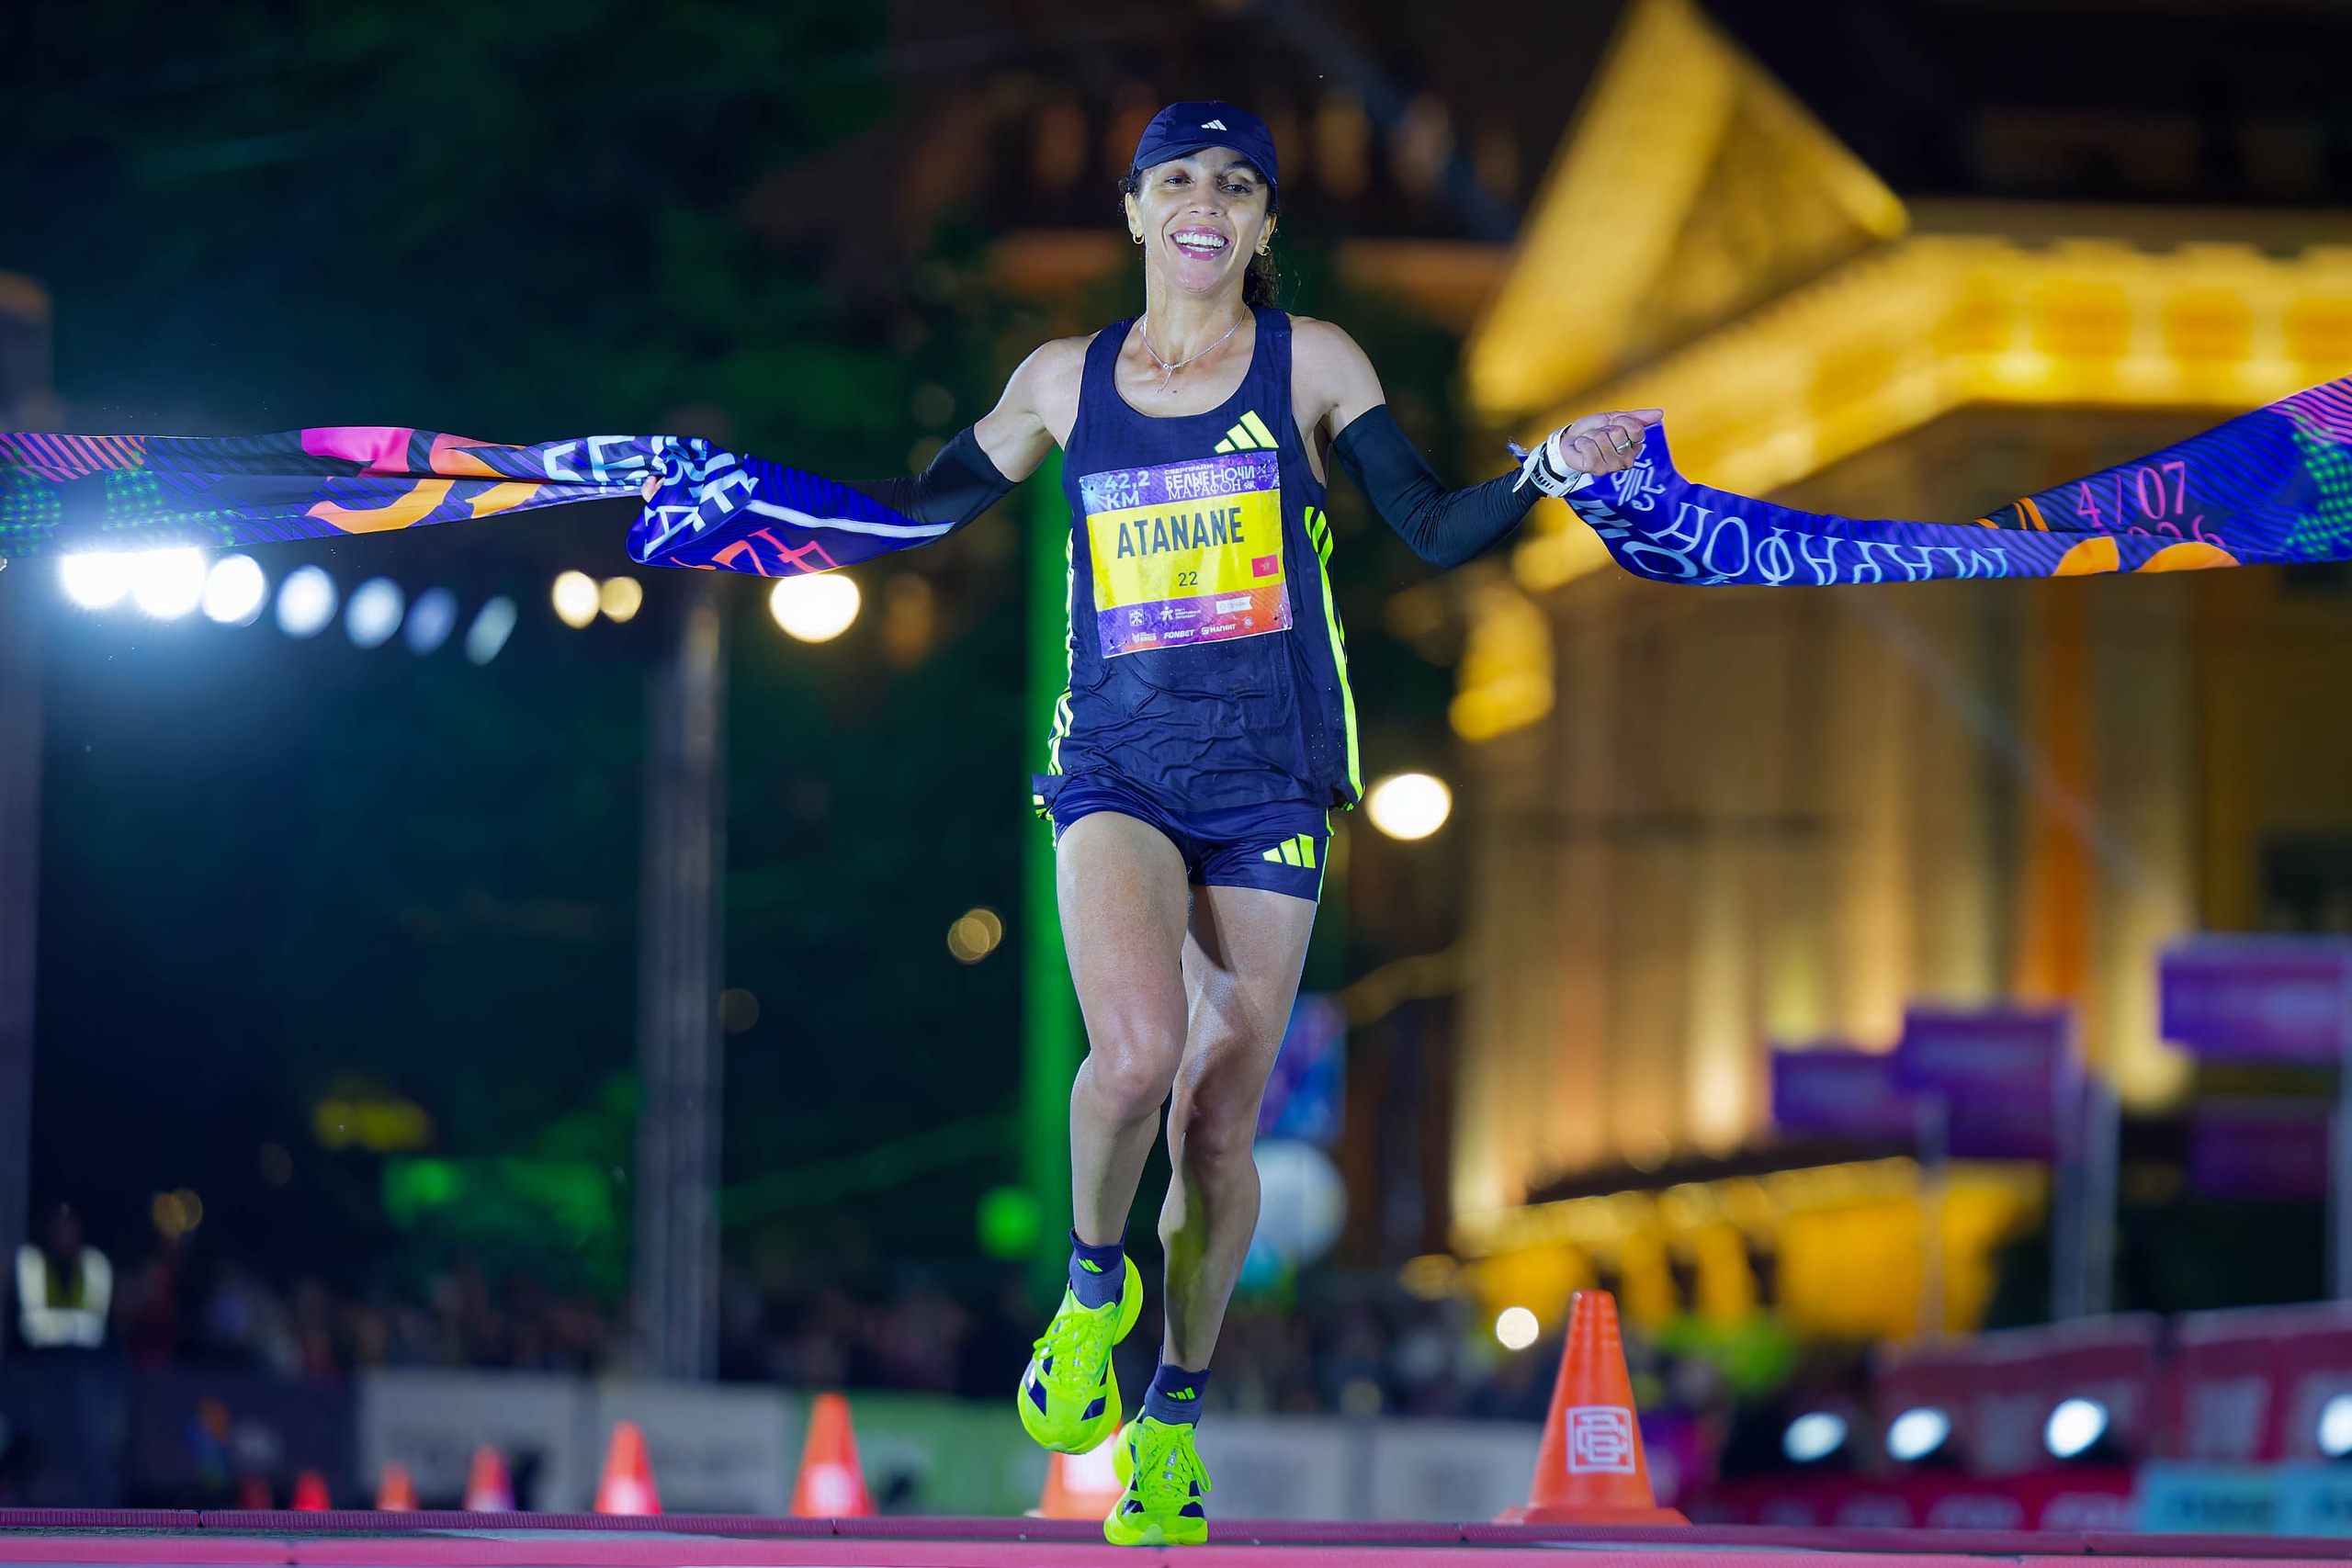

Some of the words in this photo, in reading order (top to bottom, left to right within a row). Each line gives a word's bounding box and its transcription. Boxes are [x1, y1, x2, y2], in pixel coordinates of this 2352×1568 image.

[1104, 469, 1150, 491] 42,2
[1165, 469, 1210, 490] БЕЛЫЕ
[1211, 466, 1256, 485] НОЧИ
[1169, 478, 1241, 501] МАРАФОН
[1117, 507, 1245, 559] ATANANE
[1178, 571, 1199, 587] 22
[1163, 629, 1194, 640] FONBET
